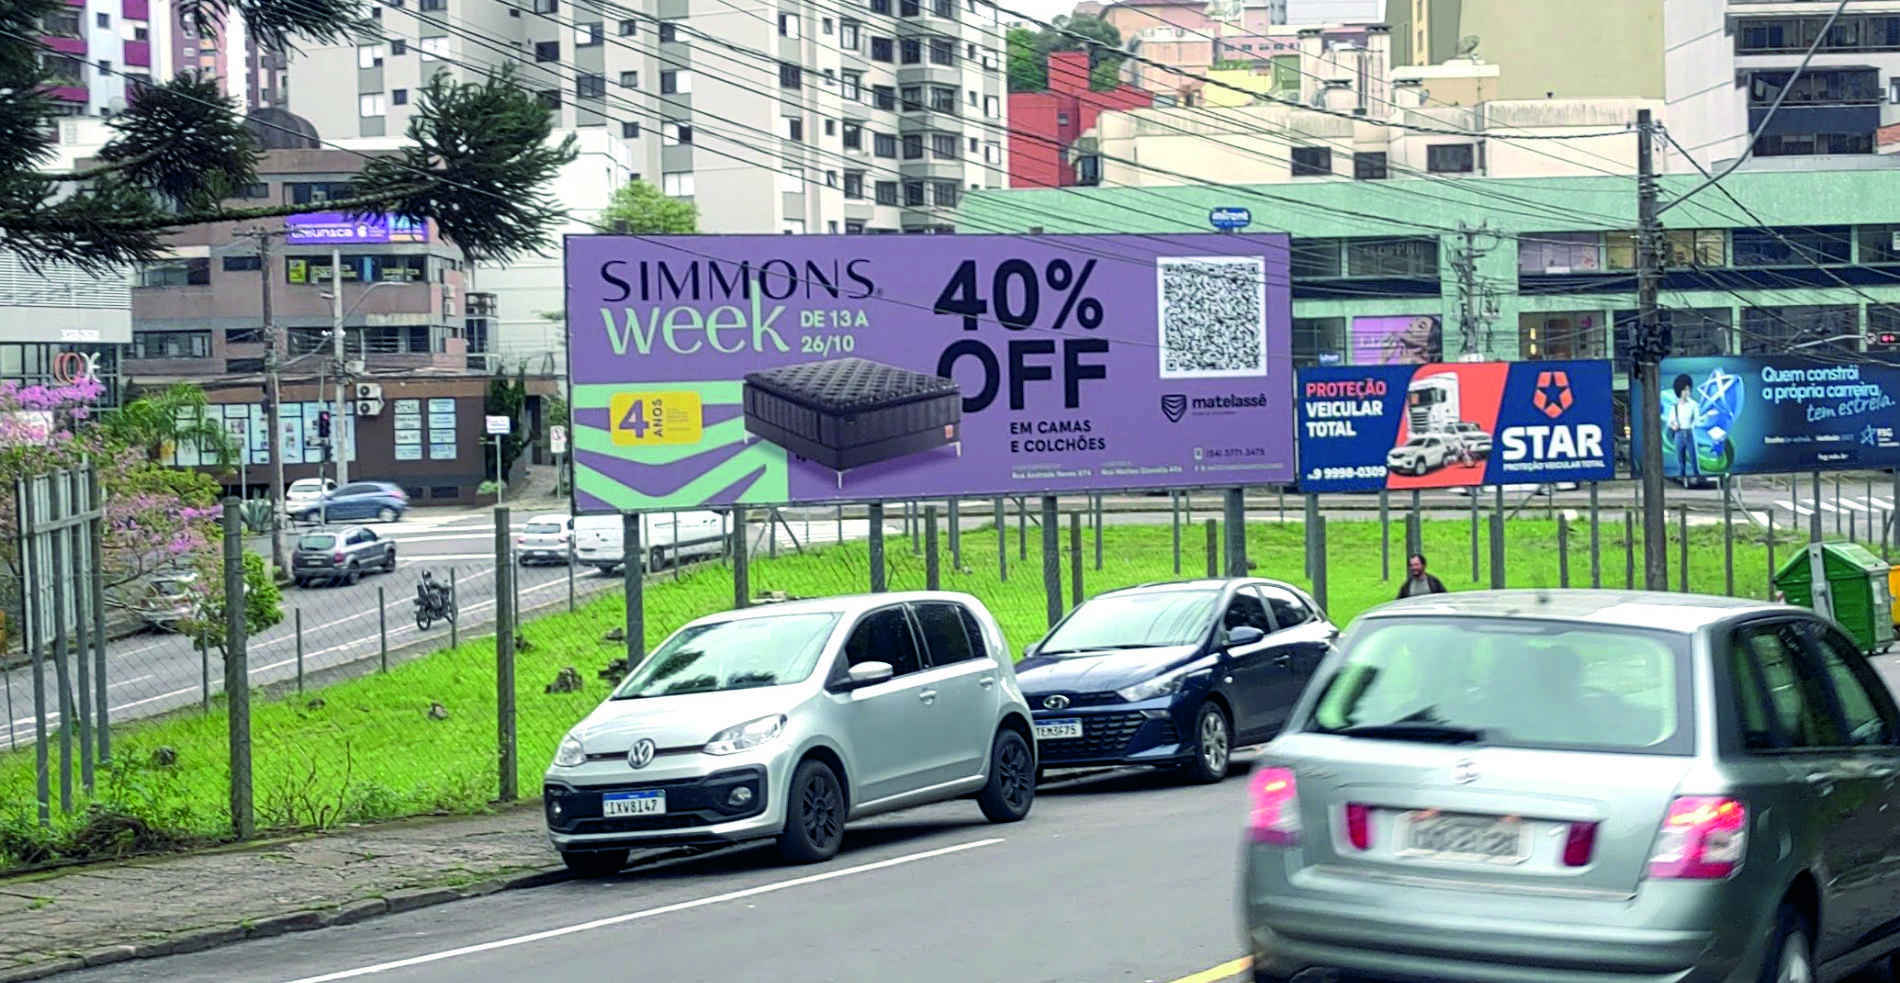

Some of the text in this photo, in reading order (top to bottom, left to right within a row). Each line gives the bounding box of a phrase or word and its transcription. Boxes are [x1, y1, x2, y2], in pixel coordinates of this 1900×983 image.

[601, 258, 875, 302] SIMMONS
[933, 258, 1104, 332] 40%
[600, 279, 791, 355] week
[800, 309, 869, 328] DE 13 A
[801, 335, 855, 357] 26/10
[936, 338, 1110, 413] OFF
[1761, 364, 1860, 382] Quem constrói
[1306, 377, 1387, 399] PROTEÇÃO
[1761, 387, 1773, 400] a
[1774, 382, 1825, 404] própria
[1192, 393, 1267, 409] matelassê
[1306, 400, 1384, 418] VEICULAR
[619, 399, 649, 438] 4
[651, 398, 663, 438] ANOS
[1807, 403, 1837, 422] tem
[1010, 419, 1092, 435] EM CAMAS
[1306, 421, 1357, 438] TOTAL
[1011, 434, 1107, 453] E COLCHÕES
[1502, 424, 1604, 460] STAR
